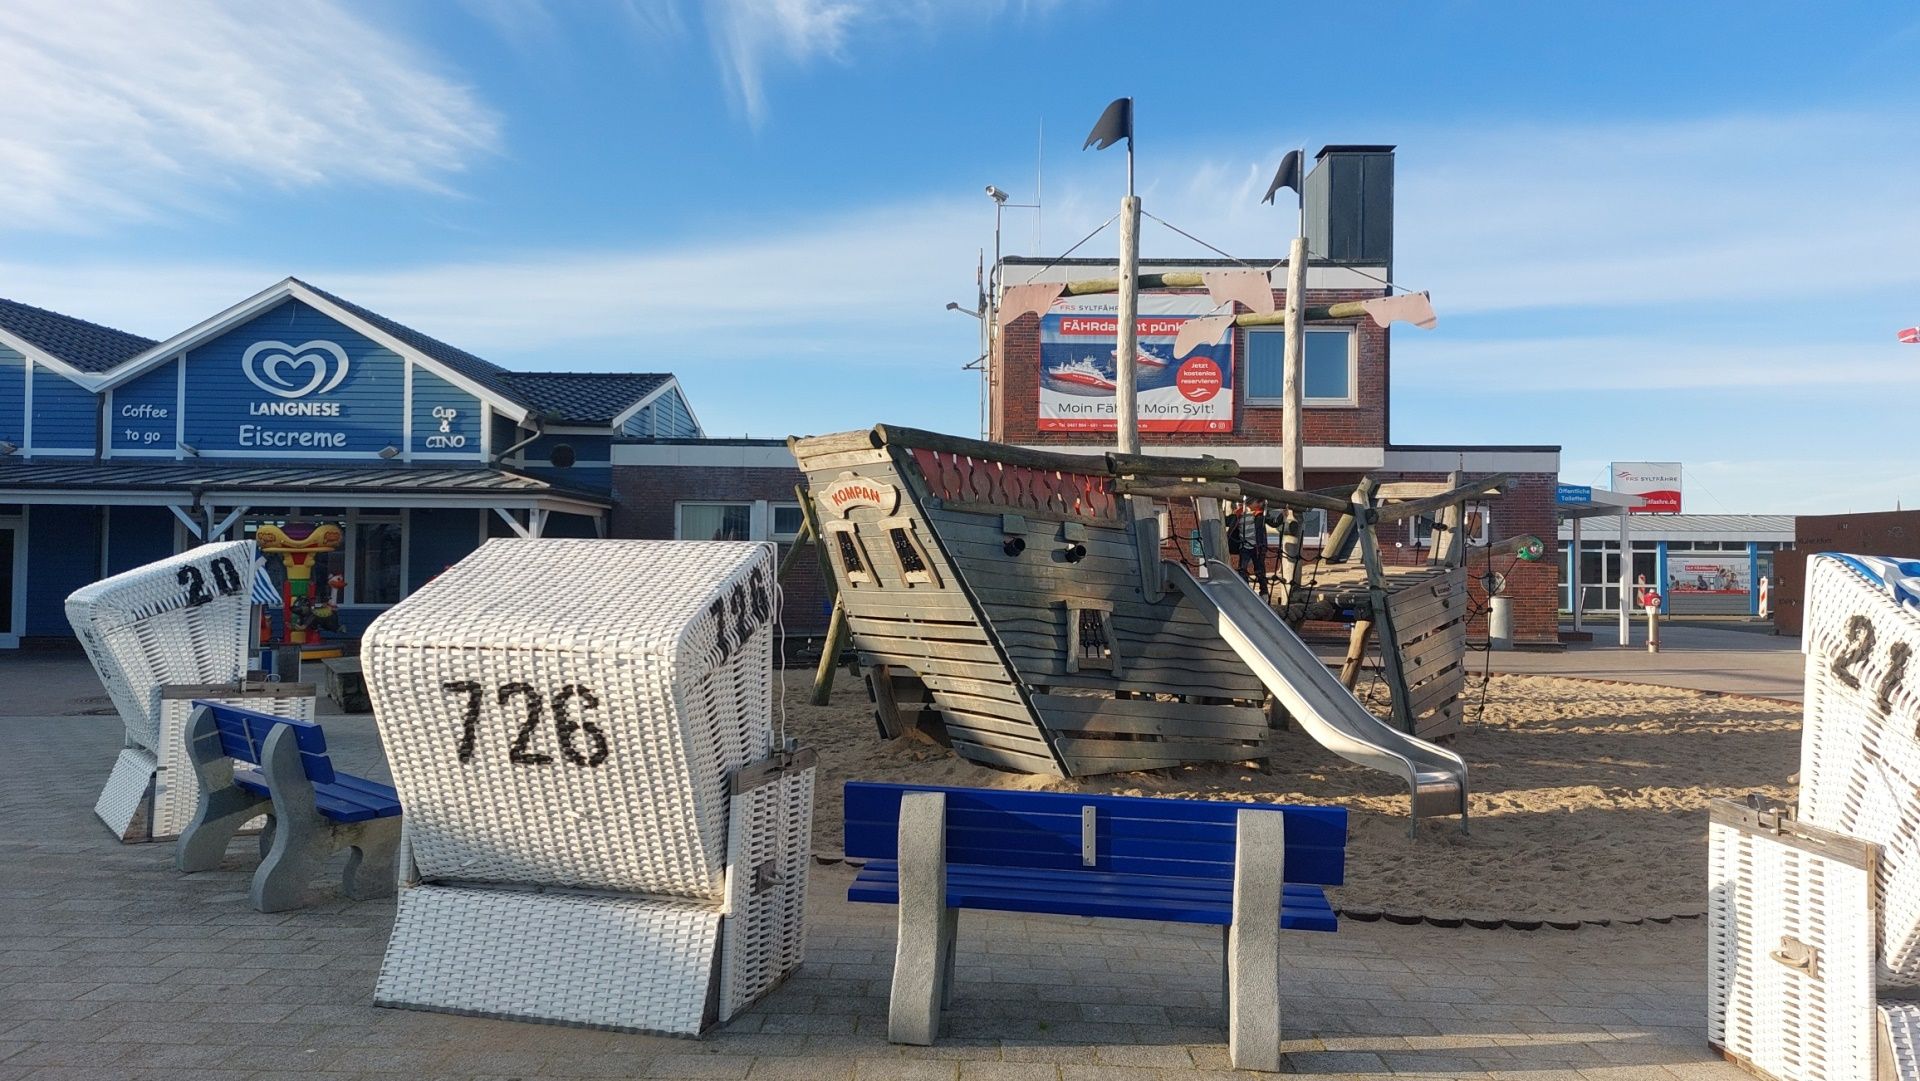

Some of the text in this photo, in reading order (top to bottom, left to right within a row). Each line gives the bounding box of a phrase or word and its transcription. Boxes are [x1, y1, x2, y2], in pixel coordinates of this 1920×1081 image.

[122, 405, 168, 418] Coffee
[250, 402, 340, 417] LANGNESE
[432, 406, 457, 419] Cup
[1058, 403, 1092, 413] Moin
[1144, 404, 1179, 413] Moin
[1183, 403, 1214, 416] Sylt!
[439, 420, 450, 433] &
[125, 429, 161, 442] to go
[239, 424, 347, 447] Eiscreme
[425, 435, 465, 449] CINO
[831, 486, 881, 507] KOMPAN
[176, 556, 241, 606] 20
[444, 679, 609, 768] 726
